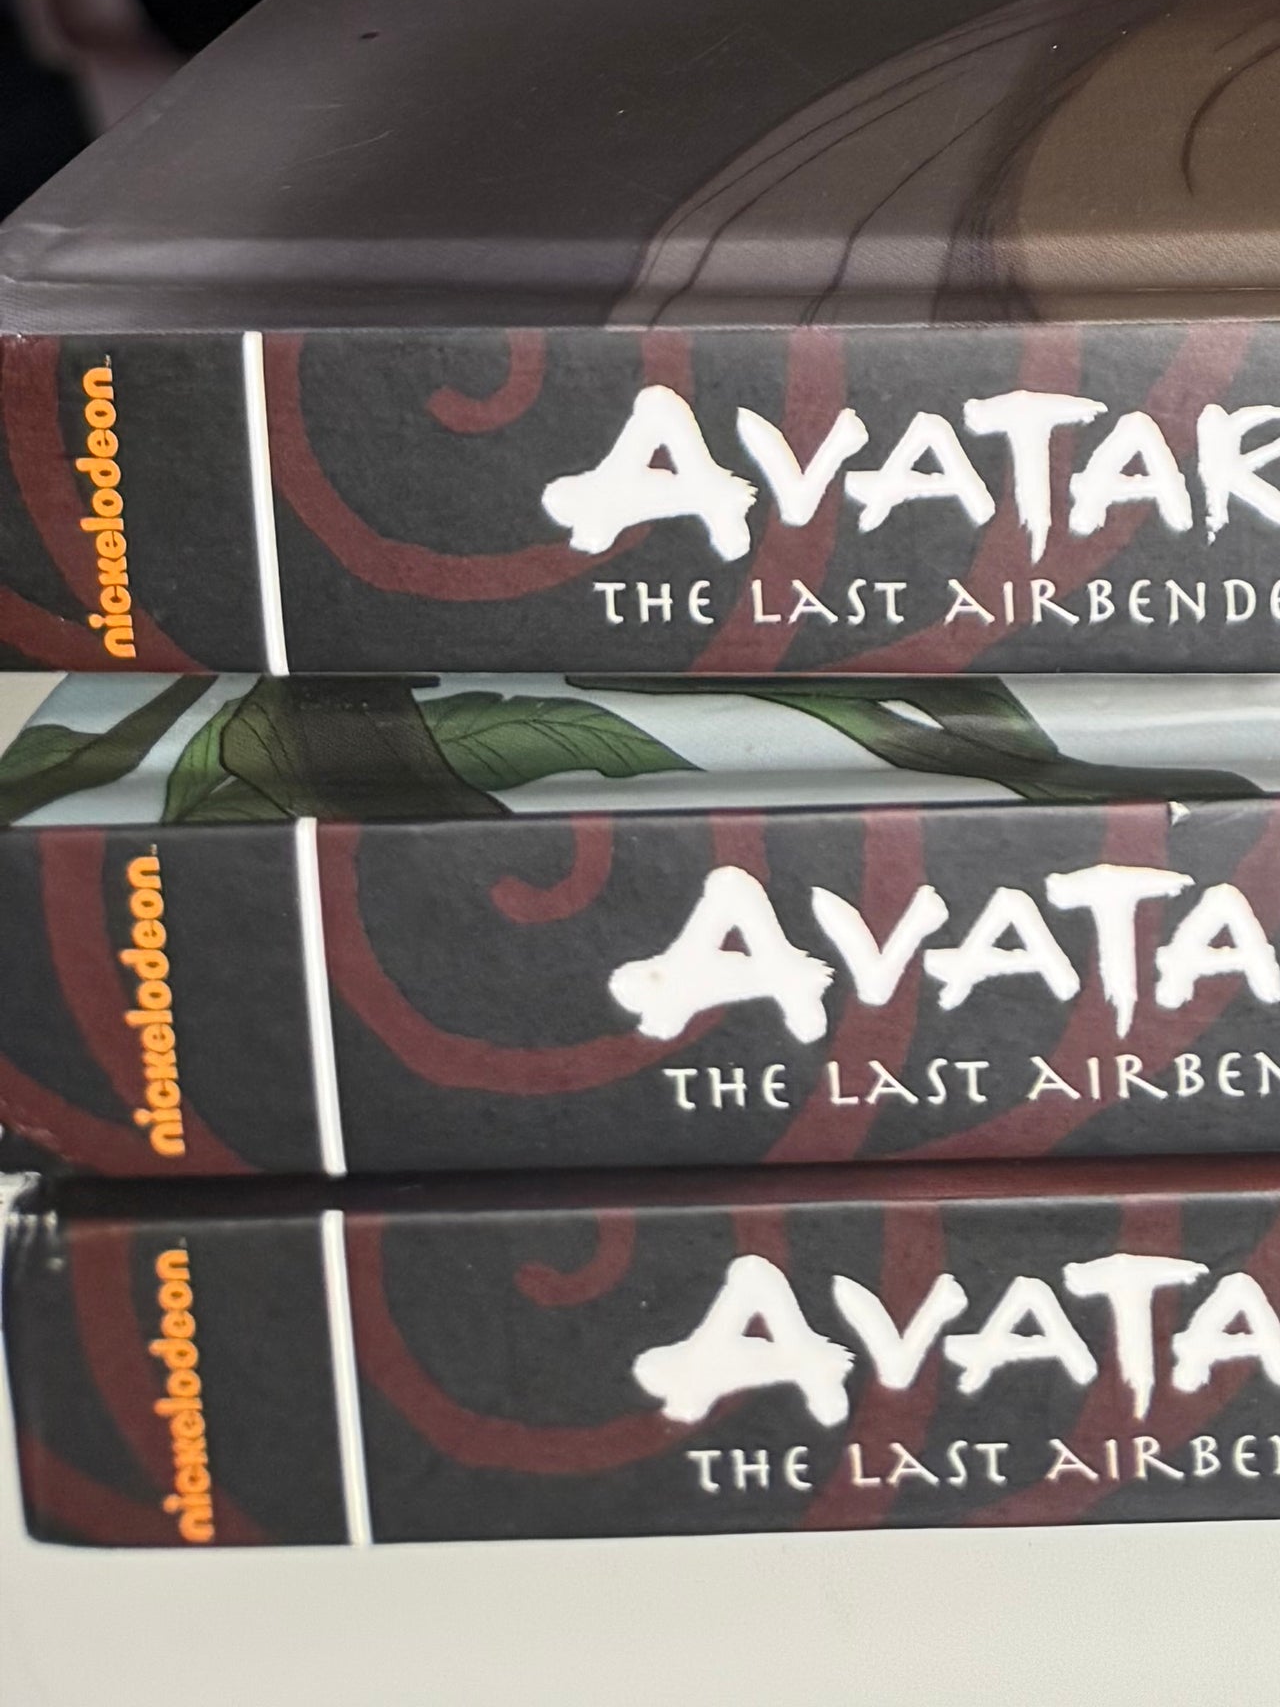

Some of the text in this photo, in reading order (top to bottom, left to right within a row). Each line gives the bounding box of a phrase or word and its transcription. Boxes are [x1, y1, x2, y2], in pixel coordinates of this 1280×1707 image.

[76, 366, 136, 658] nickelodeon
[593, 580, 714, 625] THE
[751, 578, 907, 626] LAST
[119, 856, 185, 1156] nickelodeon
[662, 1063, 790, 1111] THE
[826, 1057, 990, 1106] LAST
[149, 1249, 214, 1543] nickelodeon
[687, 1445, 812, 1493] THE
[848, 1439, 1009, 1487] LAST
